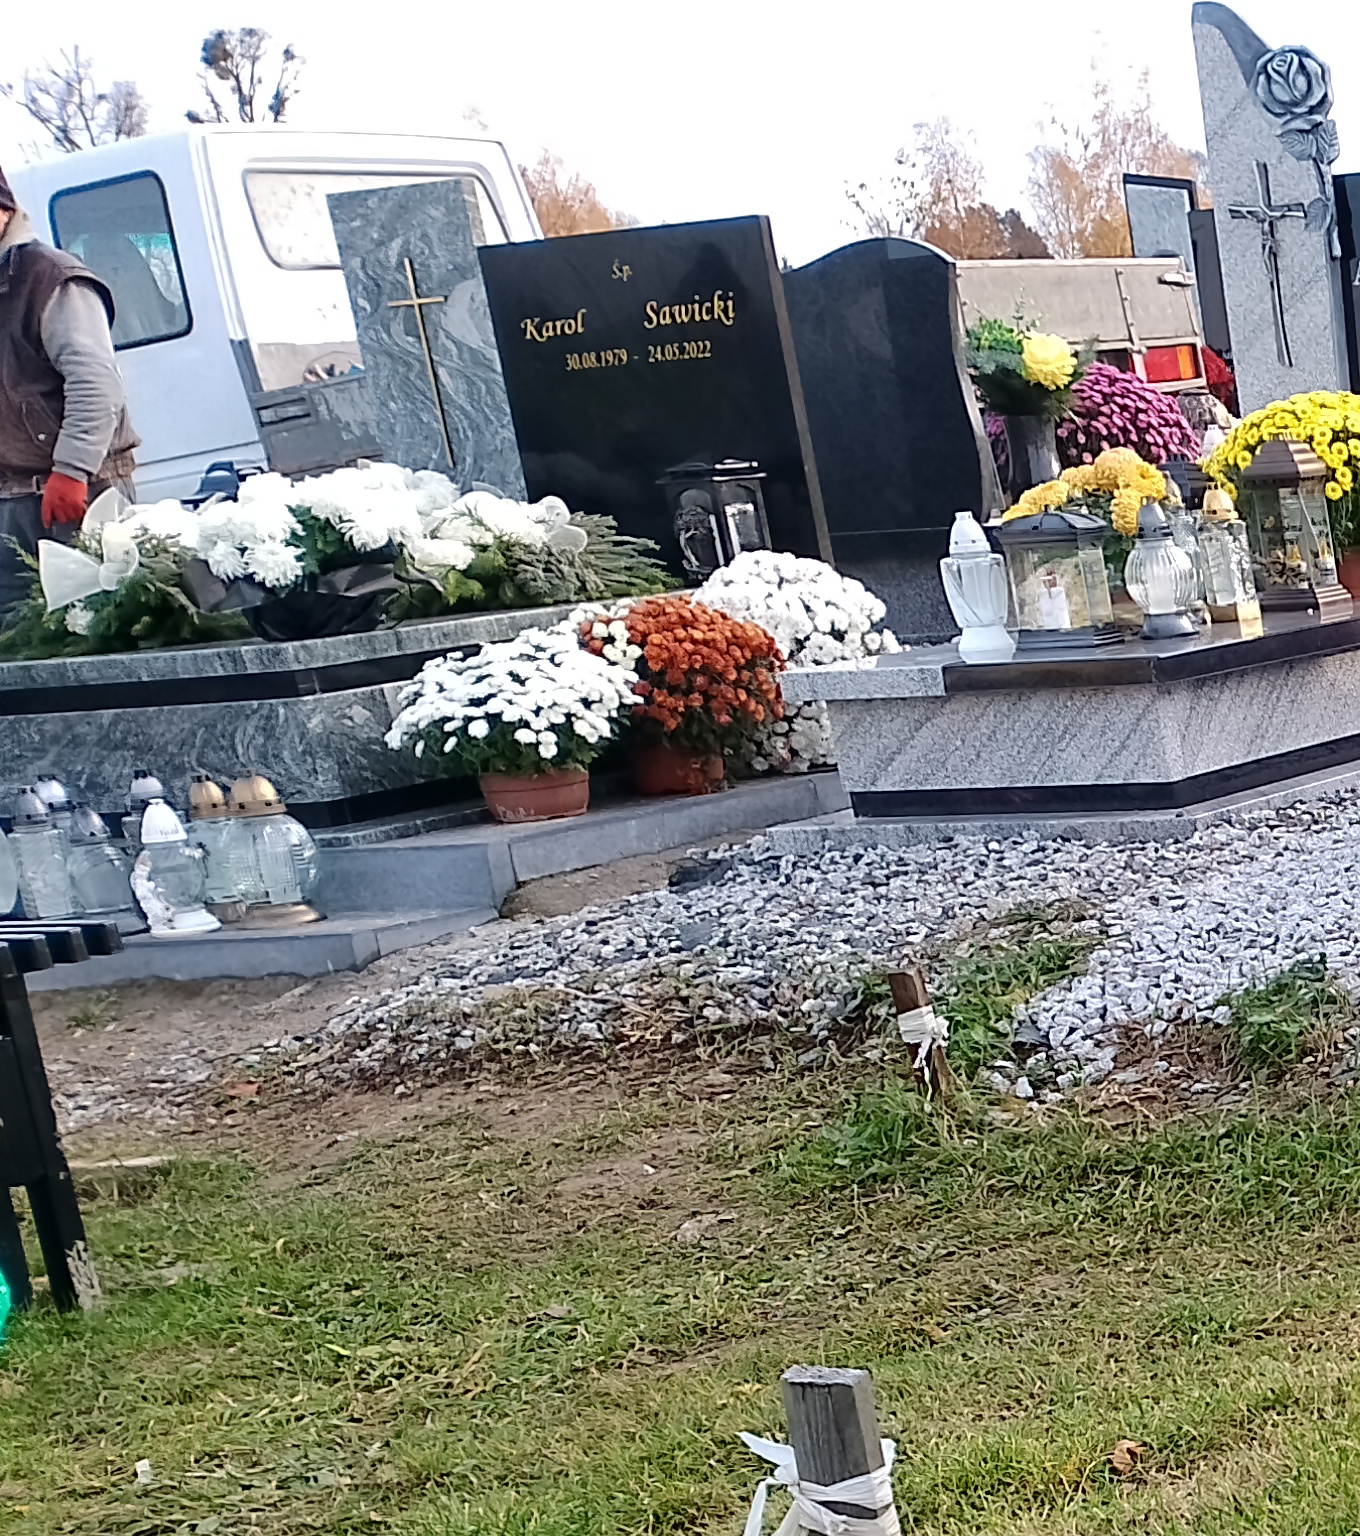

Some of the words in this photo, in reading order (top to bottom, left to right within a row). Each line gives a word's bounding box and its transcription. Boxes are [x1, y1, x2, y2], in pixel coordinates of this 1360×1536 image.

[520, 309, 587, 342] Karol
[644, 290, 735, 328] Sawicki
[565, 349, 628, 370] 30.08.1979
[648, 341, 711, 362] 24.05.2022
